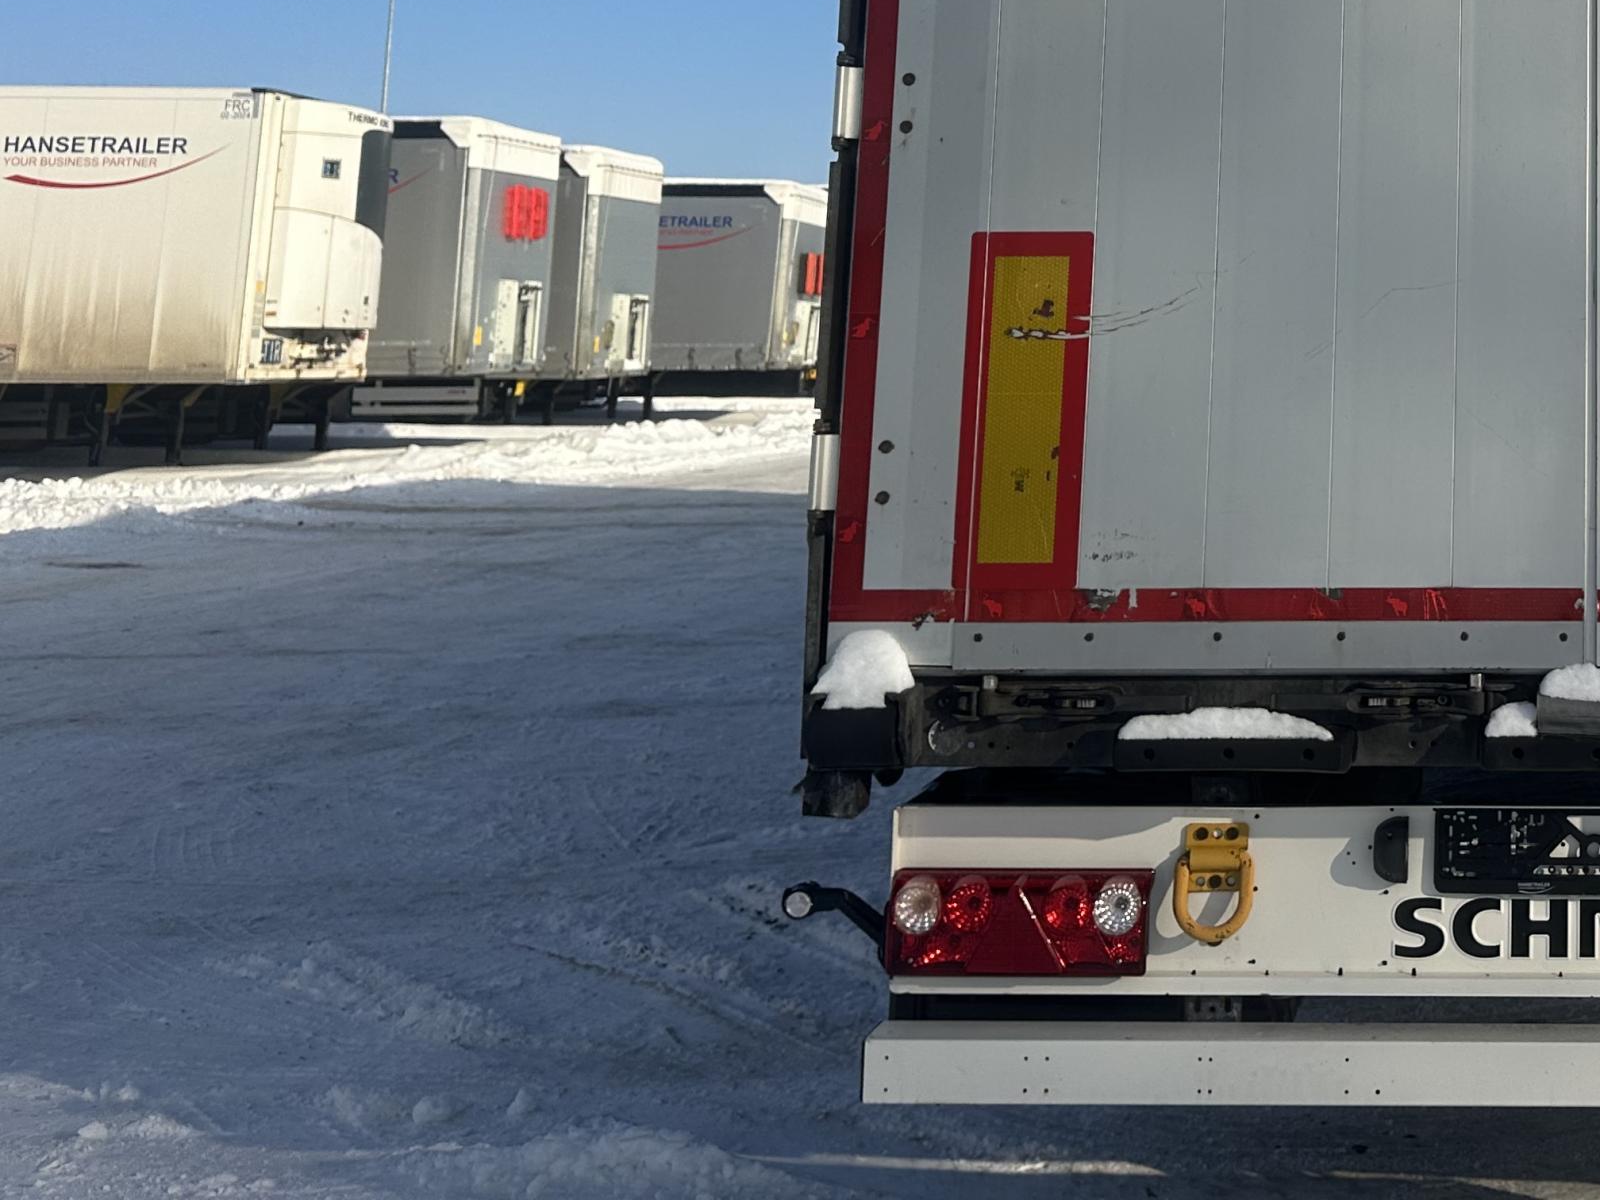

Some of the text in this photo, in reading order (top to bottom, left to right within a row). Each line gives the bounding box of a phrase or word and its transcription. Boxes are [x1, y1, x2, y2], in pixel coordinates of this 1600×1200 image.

[224, 99, 251, 112] FRC
[4, 136, 188, 154] HANSETRAILER
[4, 156, 158, 168] YOUR BUSINESS PARTNER
